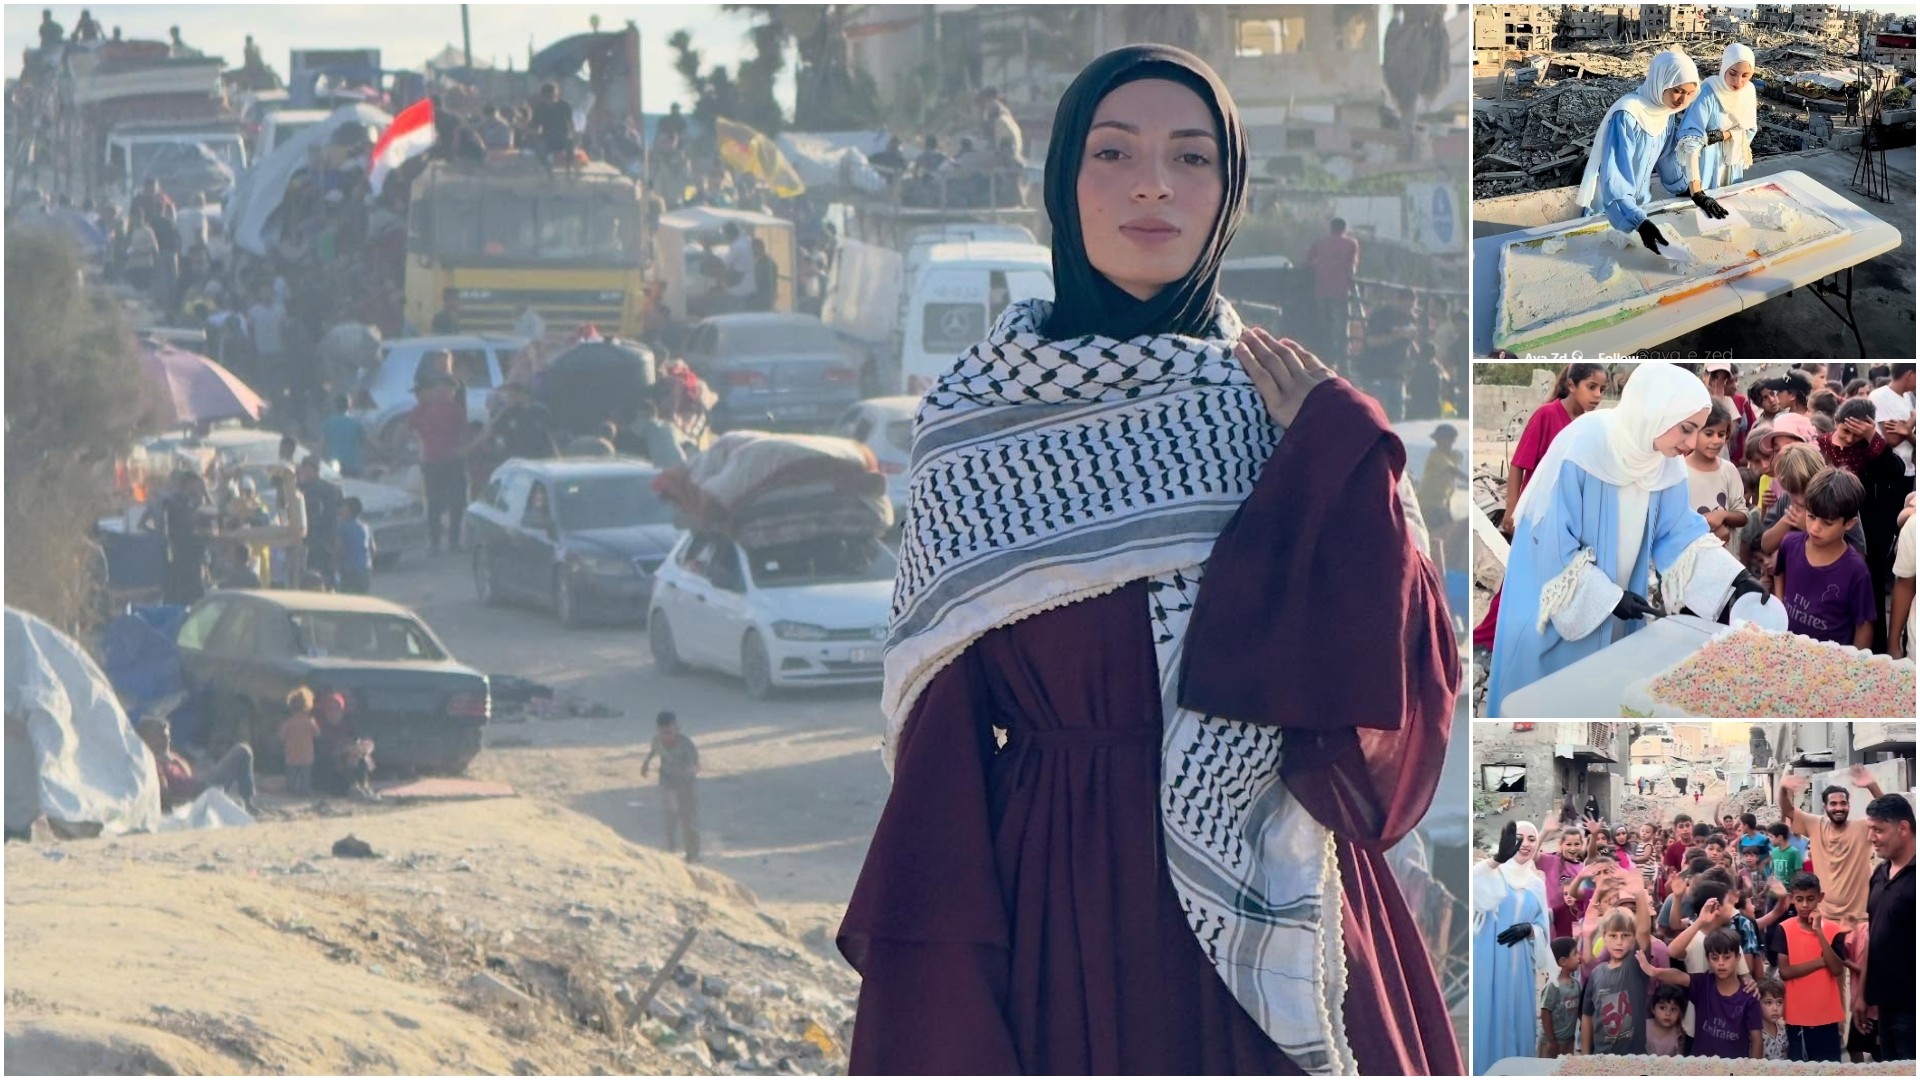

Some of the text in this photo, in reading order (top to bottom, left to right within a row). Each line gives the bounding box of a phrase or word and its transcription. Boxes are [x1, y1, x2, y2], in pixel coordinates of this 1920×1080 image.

[1793, 593, 1811, 610] Fly
[1784, 597, 1828, 631] mirates
[1702, 1020, 1740, 1041] Emirates
